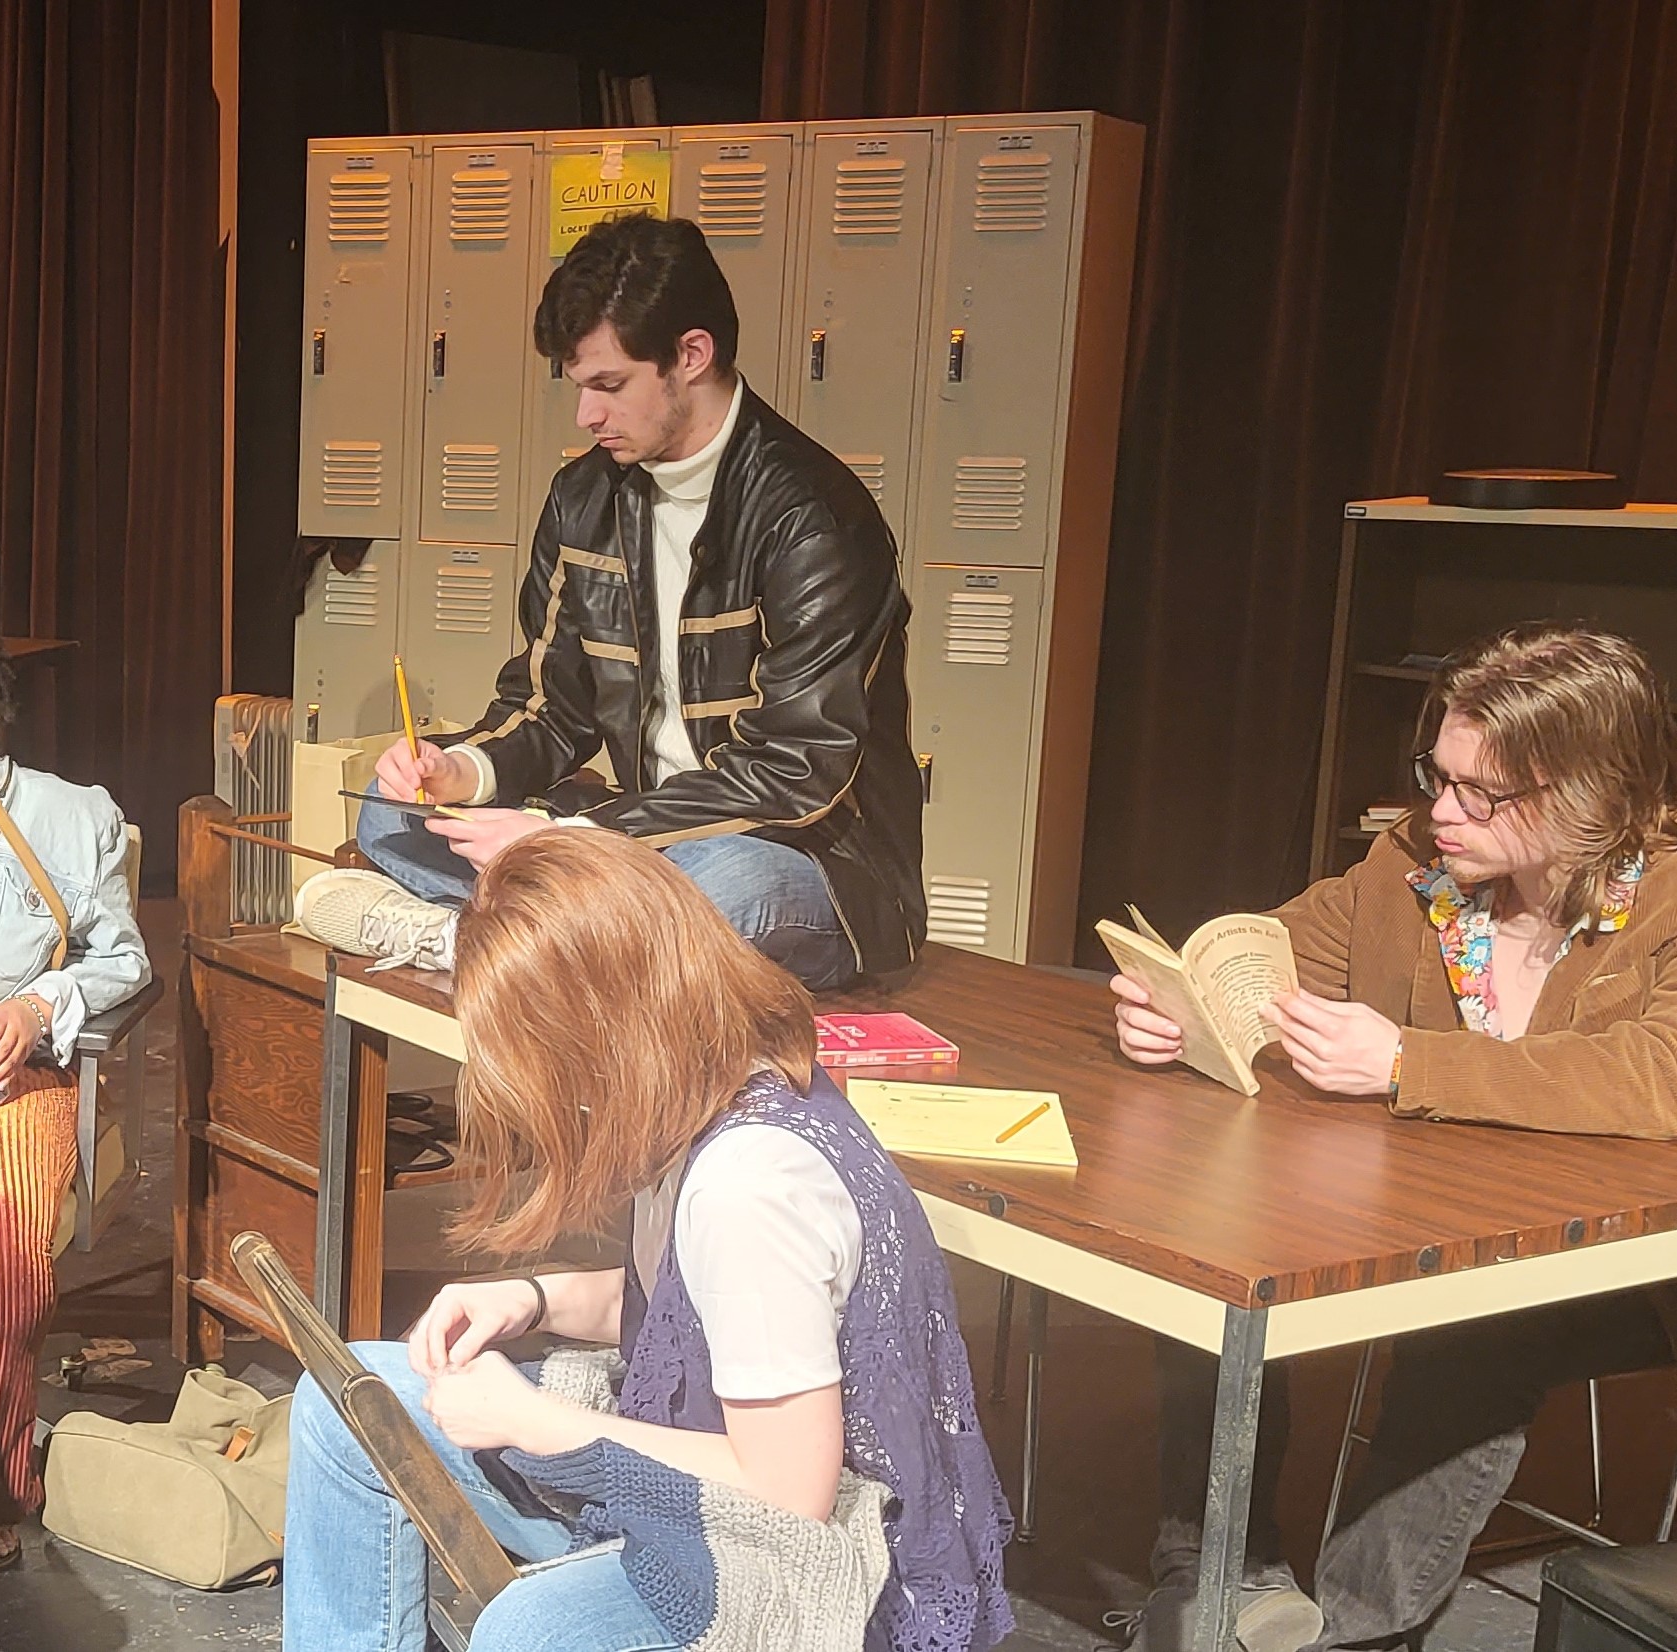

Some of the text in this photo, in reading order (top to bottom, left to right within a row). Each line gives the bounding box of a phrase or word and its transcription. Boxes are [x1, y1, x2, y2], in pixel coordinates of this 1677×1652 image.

[562, 179, 656, 203] CAUTION
[560, 224, 588, 234] LOCKE
[1216, 926, 1247, 941] Artists
[1249, 926, 1263, 935] On
